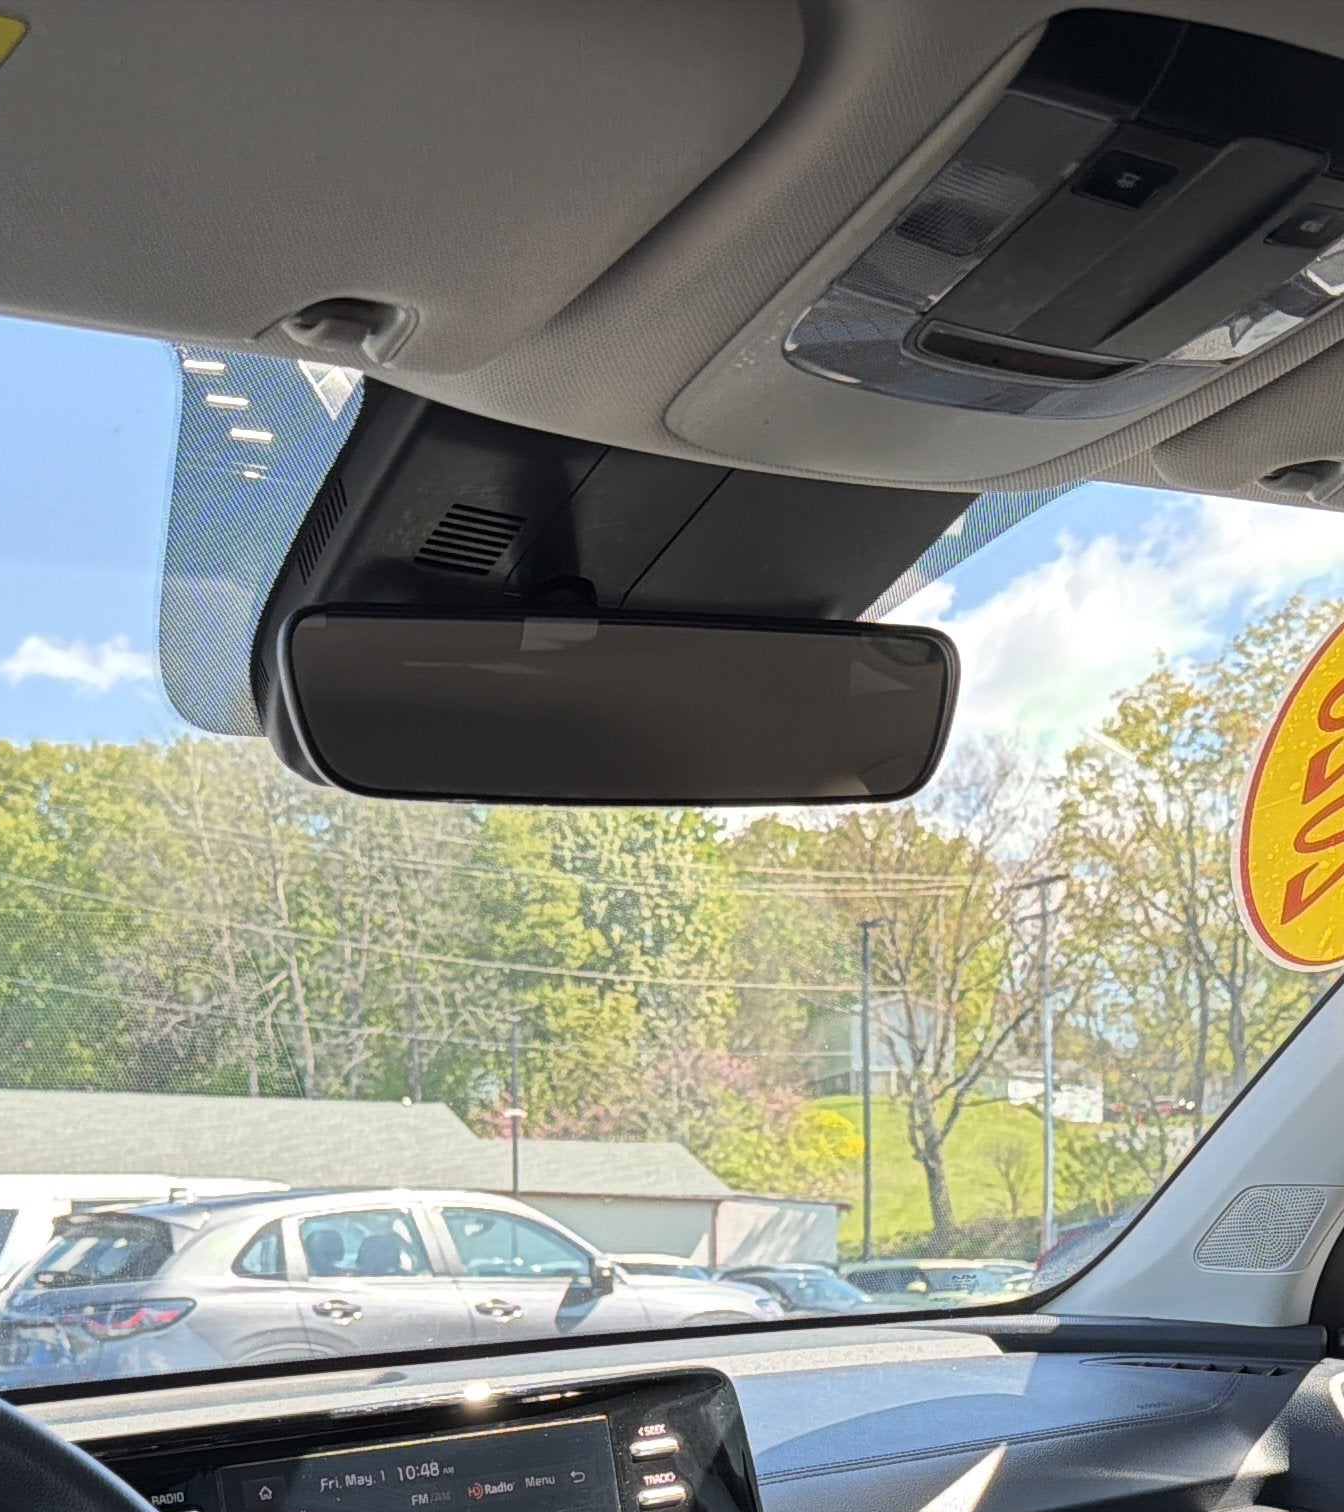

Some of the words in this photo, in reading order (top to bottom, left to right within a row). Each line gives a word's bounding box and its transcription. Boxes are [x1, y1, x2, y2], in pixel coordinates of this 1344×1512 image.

[379, 1470, 386, 1482] 1
[397, 1461, 440, 1482] 10:48
[442, 1466, 455, 1476] AM
[484, 1481, 515, 1495] Radio
[524, 1476, 556, 1489] Menu
[151, 1491, 185, 1506] RADIO
[411, 1493, 429, 1506] FM
